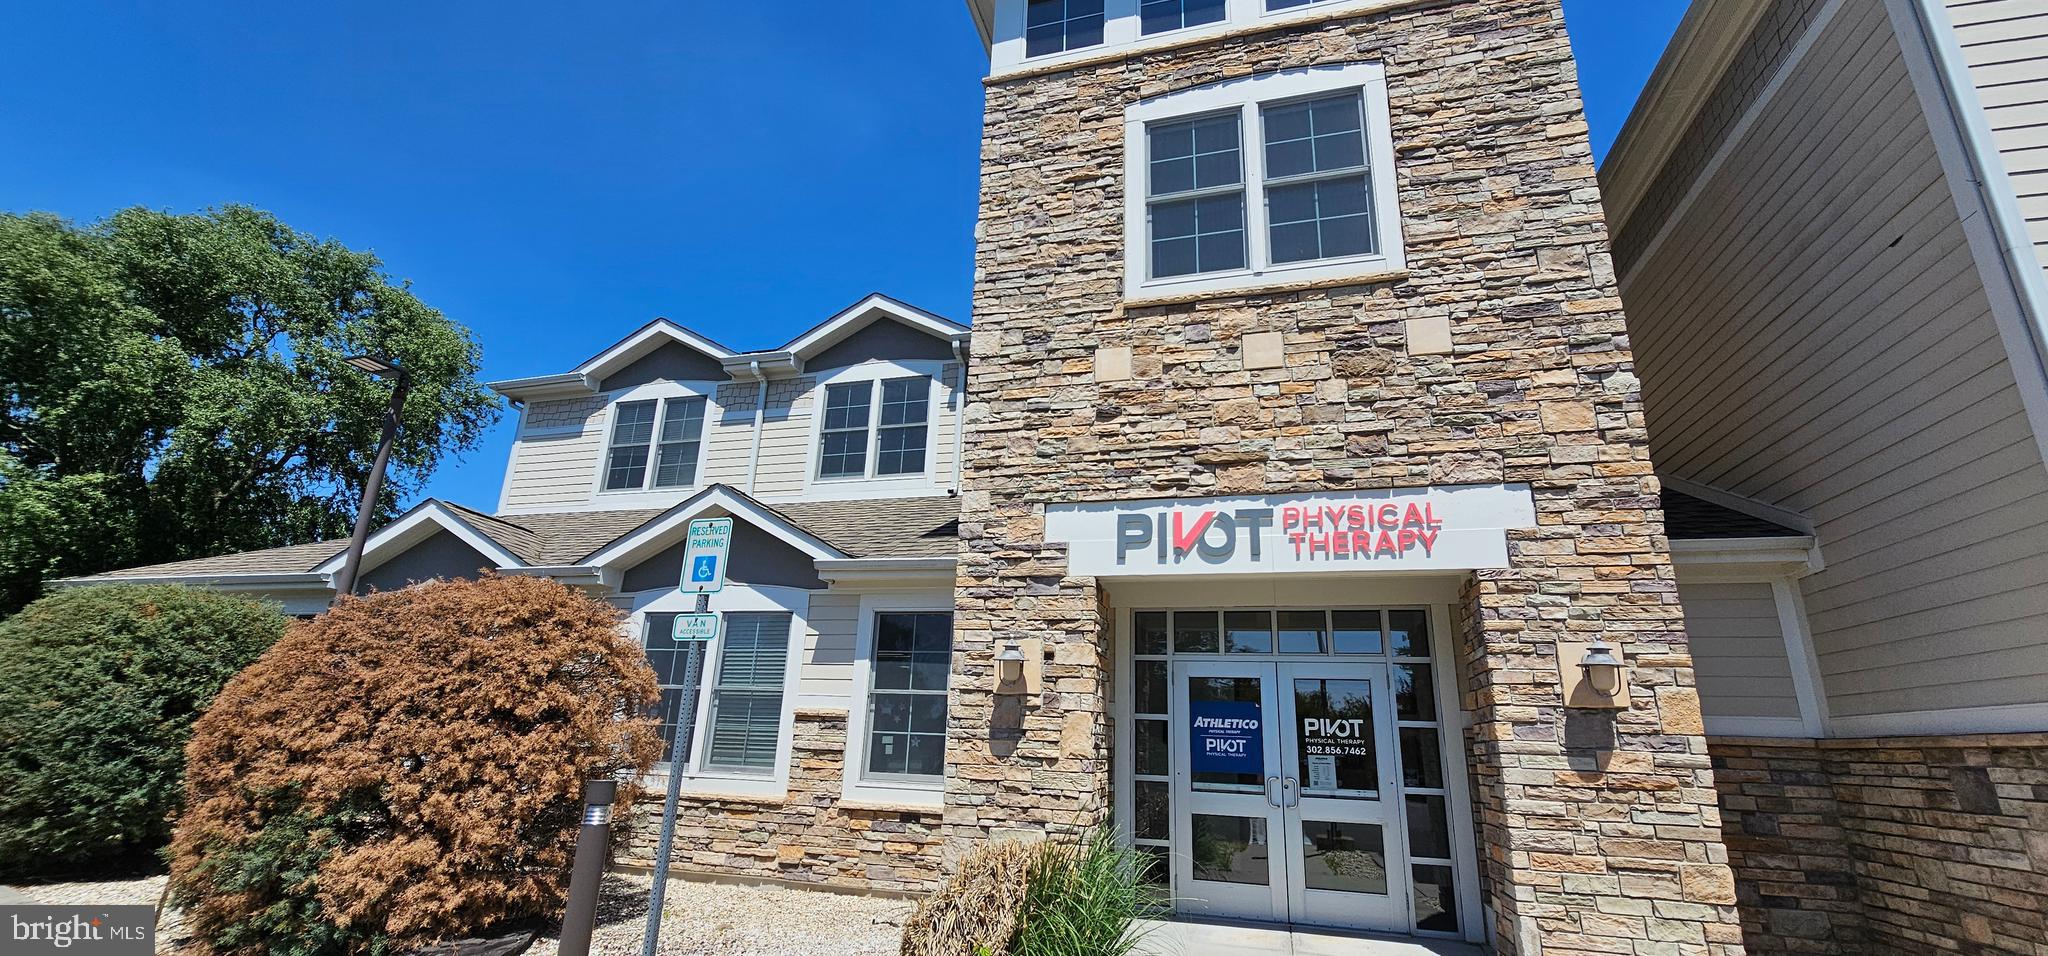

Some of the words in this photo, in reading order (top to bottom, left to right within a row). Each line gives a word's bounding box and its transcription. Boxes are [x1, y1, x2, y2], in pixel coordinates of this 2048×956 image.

[1283, 502, 1443, 532] PHYSICAL
[691, 525, 728, 536] RESERVED
[1117, 508, 1274, 565] PIVOT
[692, 538, 724, 548] PARKING
[1289, 528, 1439, 558] THERAPY
[1304, 718, 1364, 737] PIVOT
[1206, 738, 1246, 752] PIVOT
[1306, 745, 1366, 756] 302.856.7462
